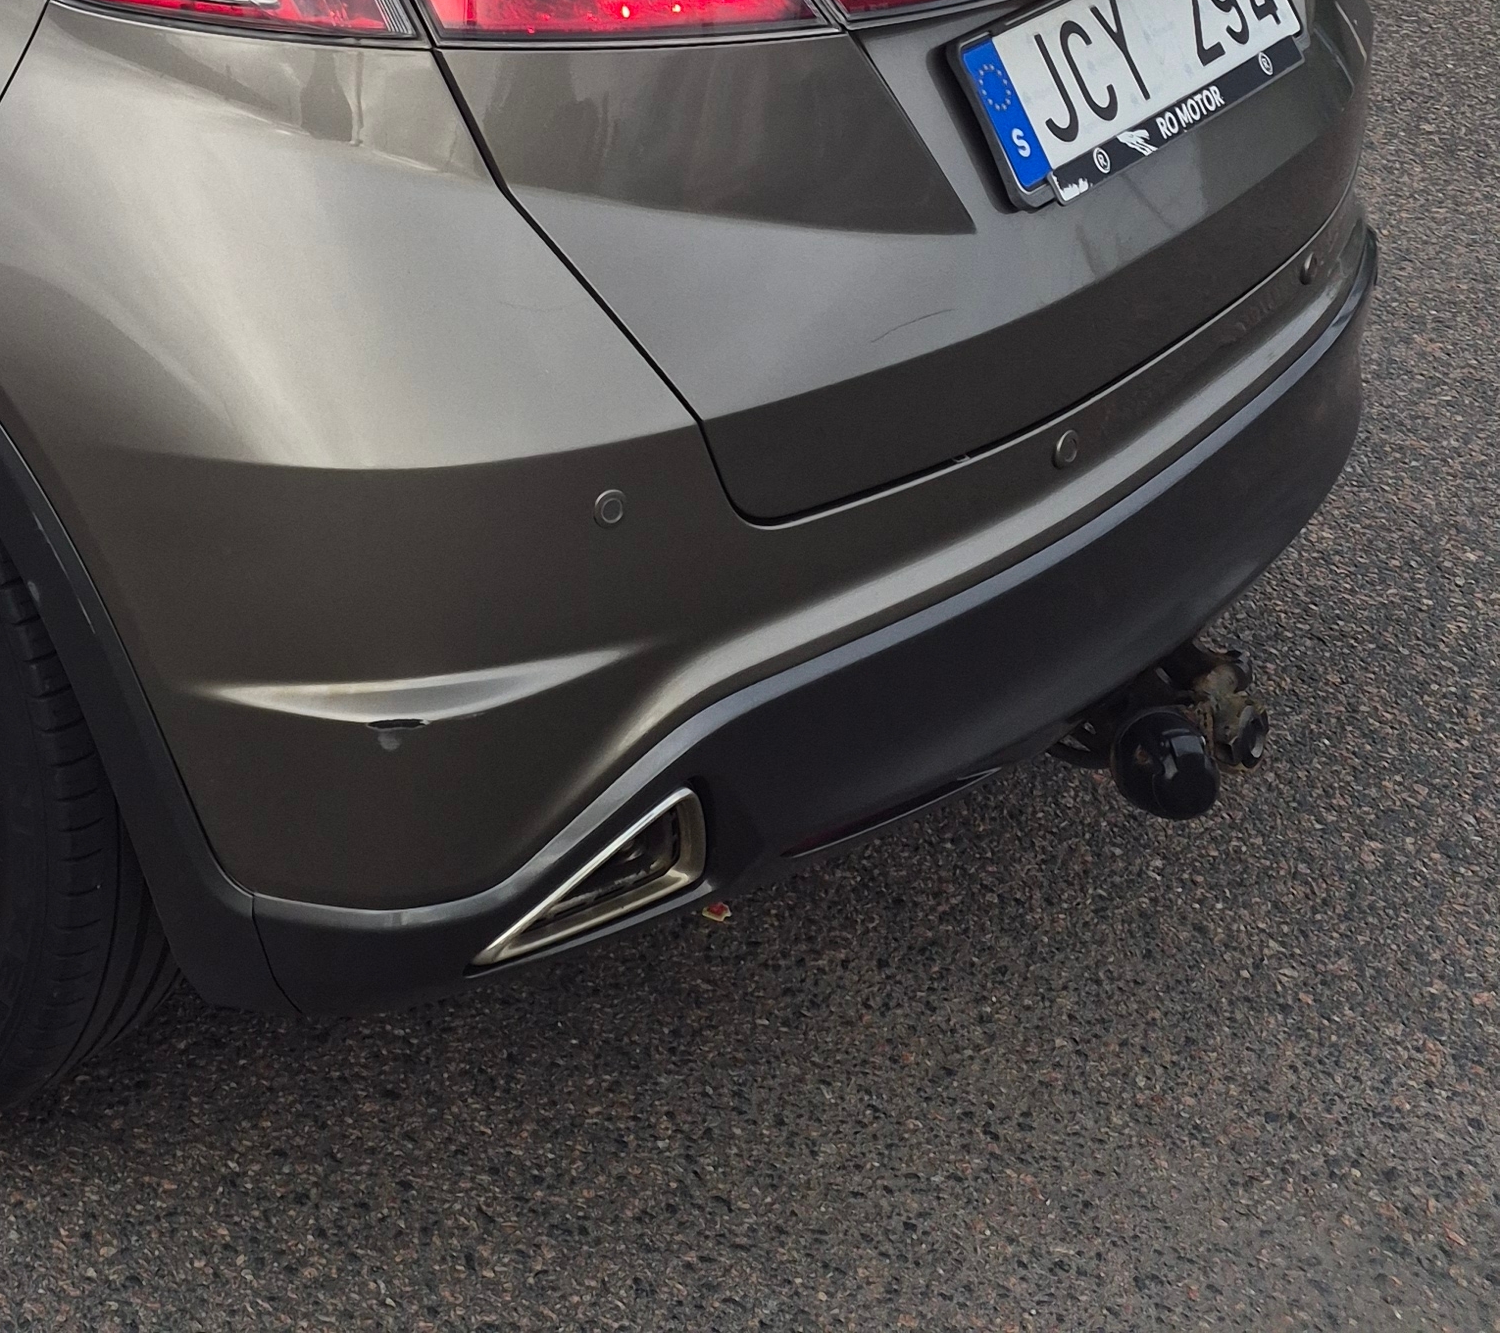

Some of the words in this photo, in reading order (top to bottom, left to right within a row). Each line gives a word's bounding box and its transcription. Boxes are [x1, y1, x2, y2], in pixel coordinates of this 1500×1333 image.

[1155, 111, 1180, 140] RO
[1174, 84, 1226, 129] MOTOR
[1011, 128, 1032, 158] S
